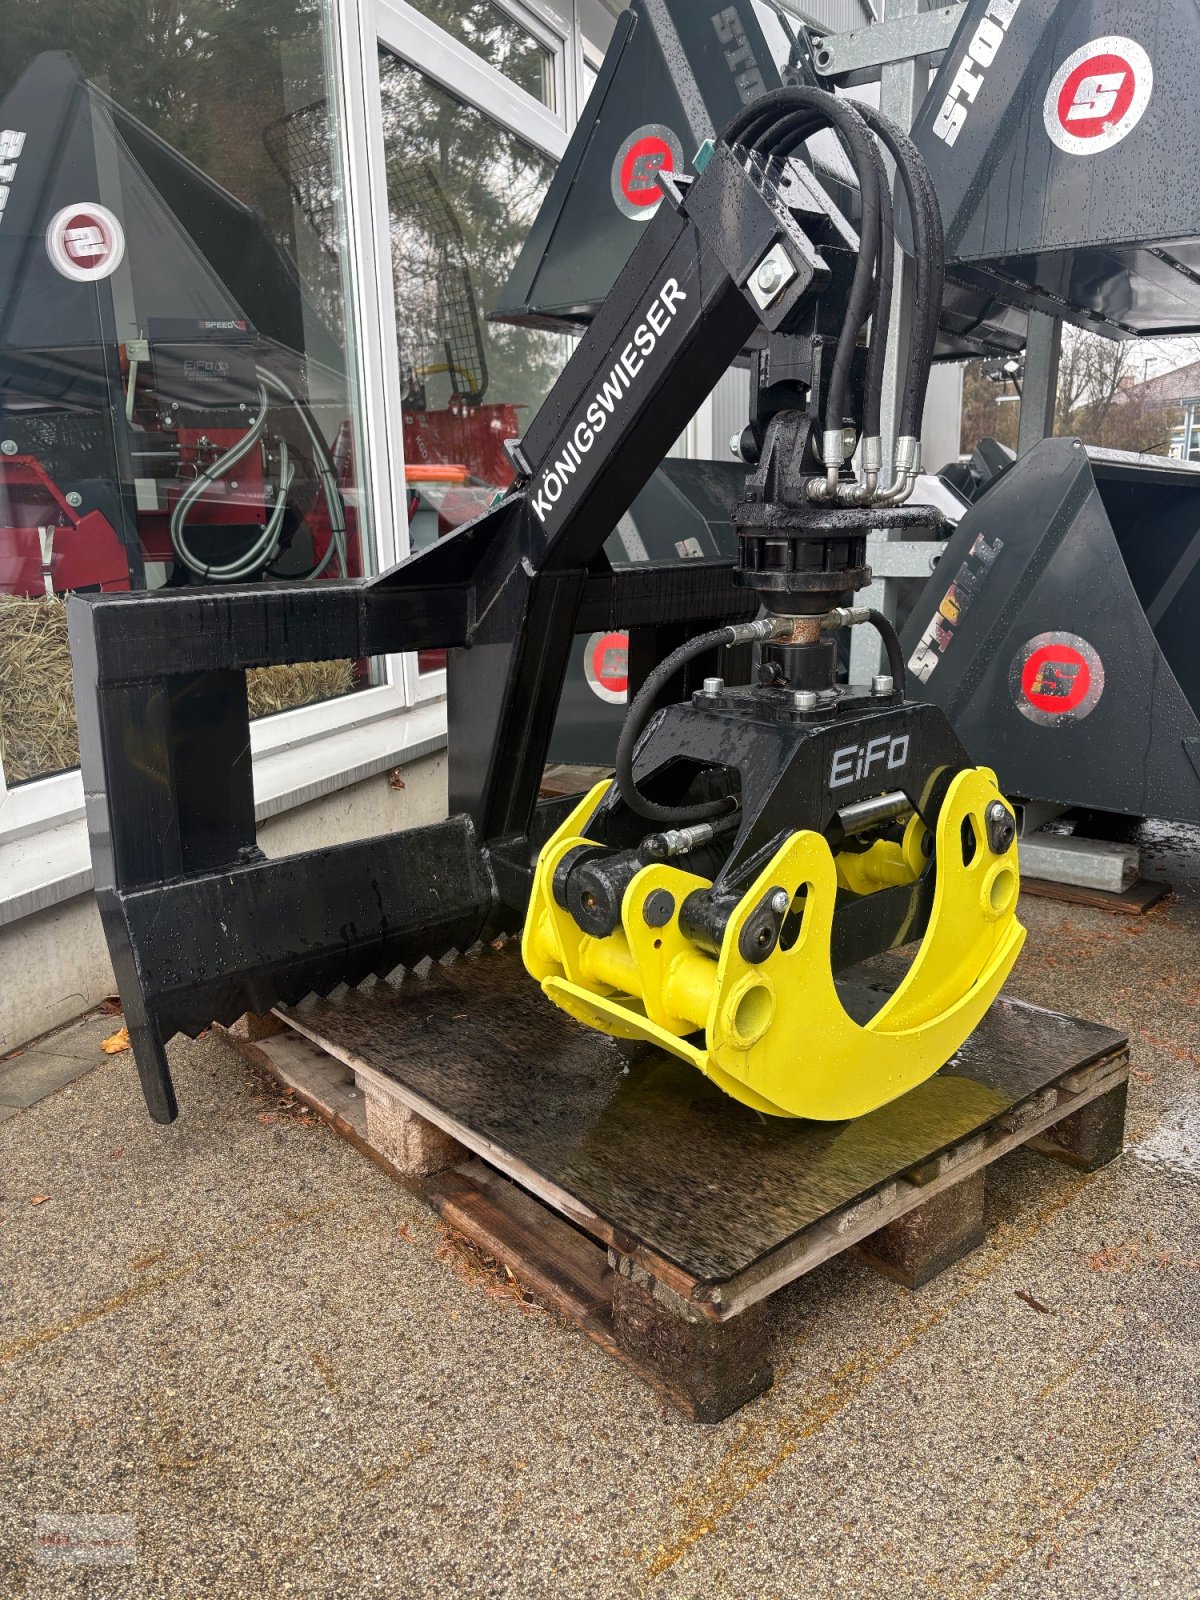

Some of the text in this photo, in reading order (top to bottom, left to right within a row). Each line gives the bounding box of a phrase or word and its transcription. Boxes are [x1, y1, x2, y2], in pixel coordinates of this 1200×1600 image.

[1066, 72, 1126, 120] S
[531, 278, 687, 522] KÖNIGSWIESER
[908, 532, 1004, 685] STOLL
[1031, 661, 1081, 697] S
